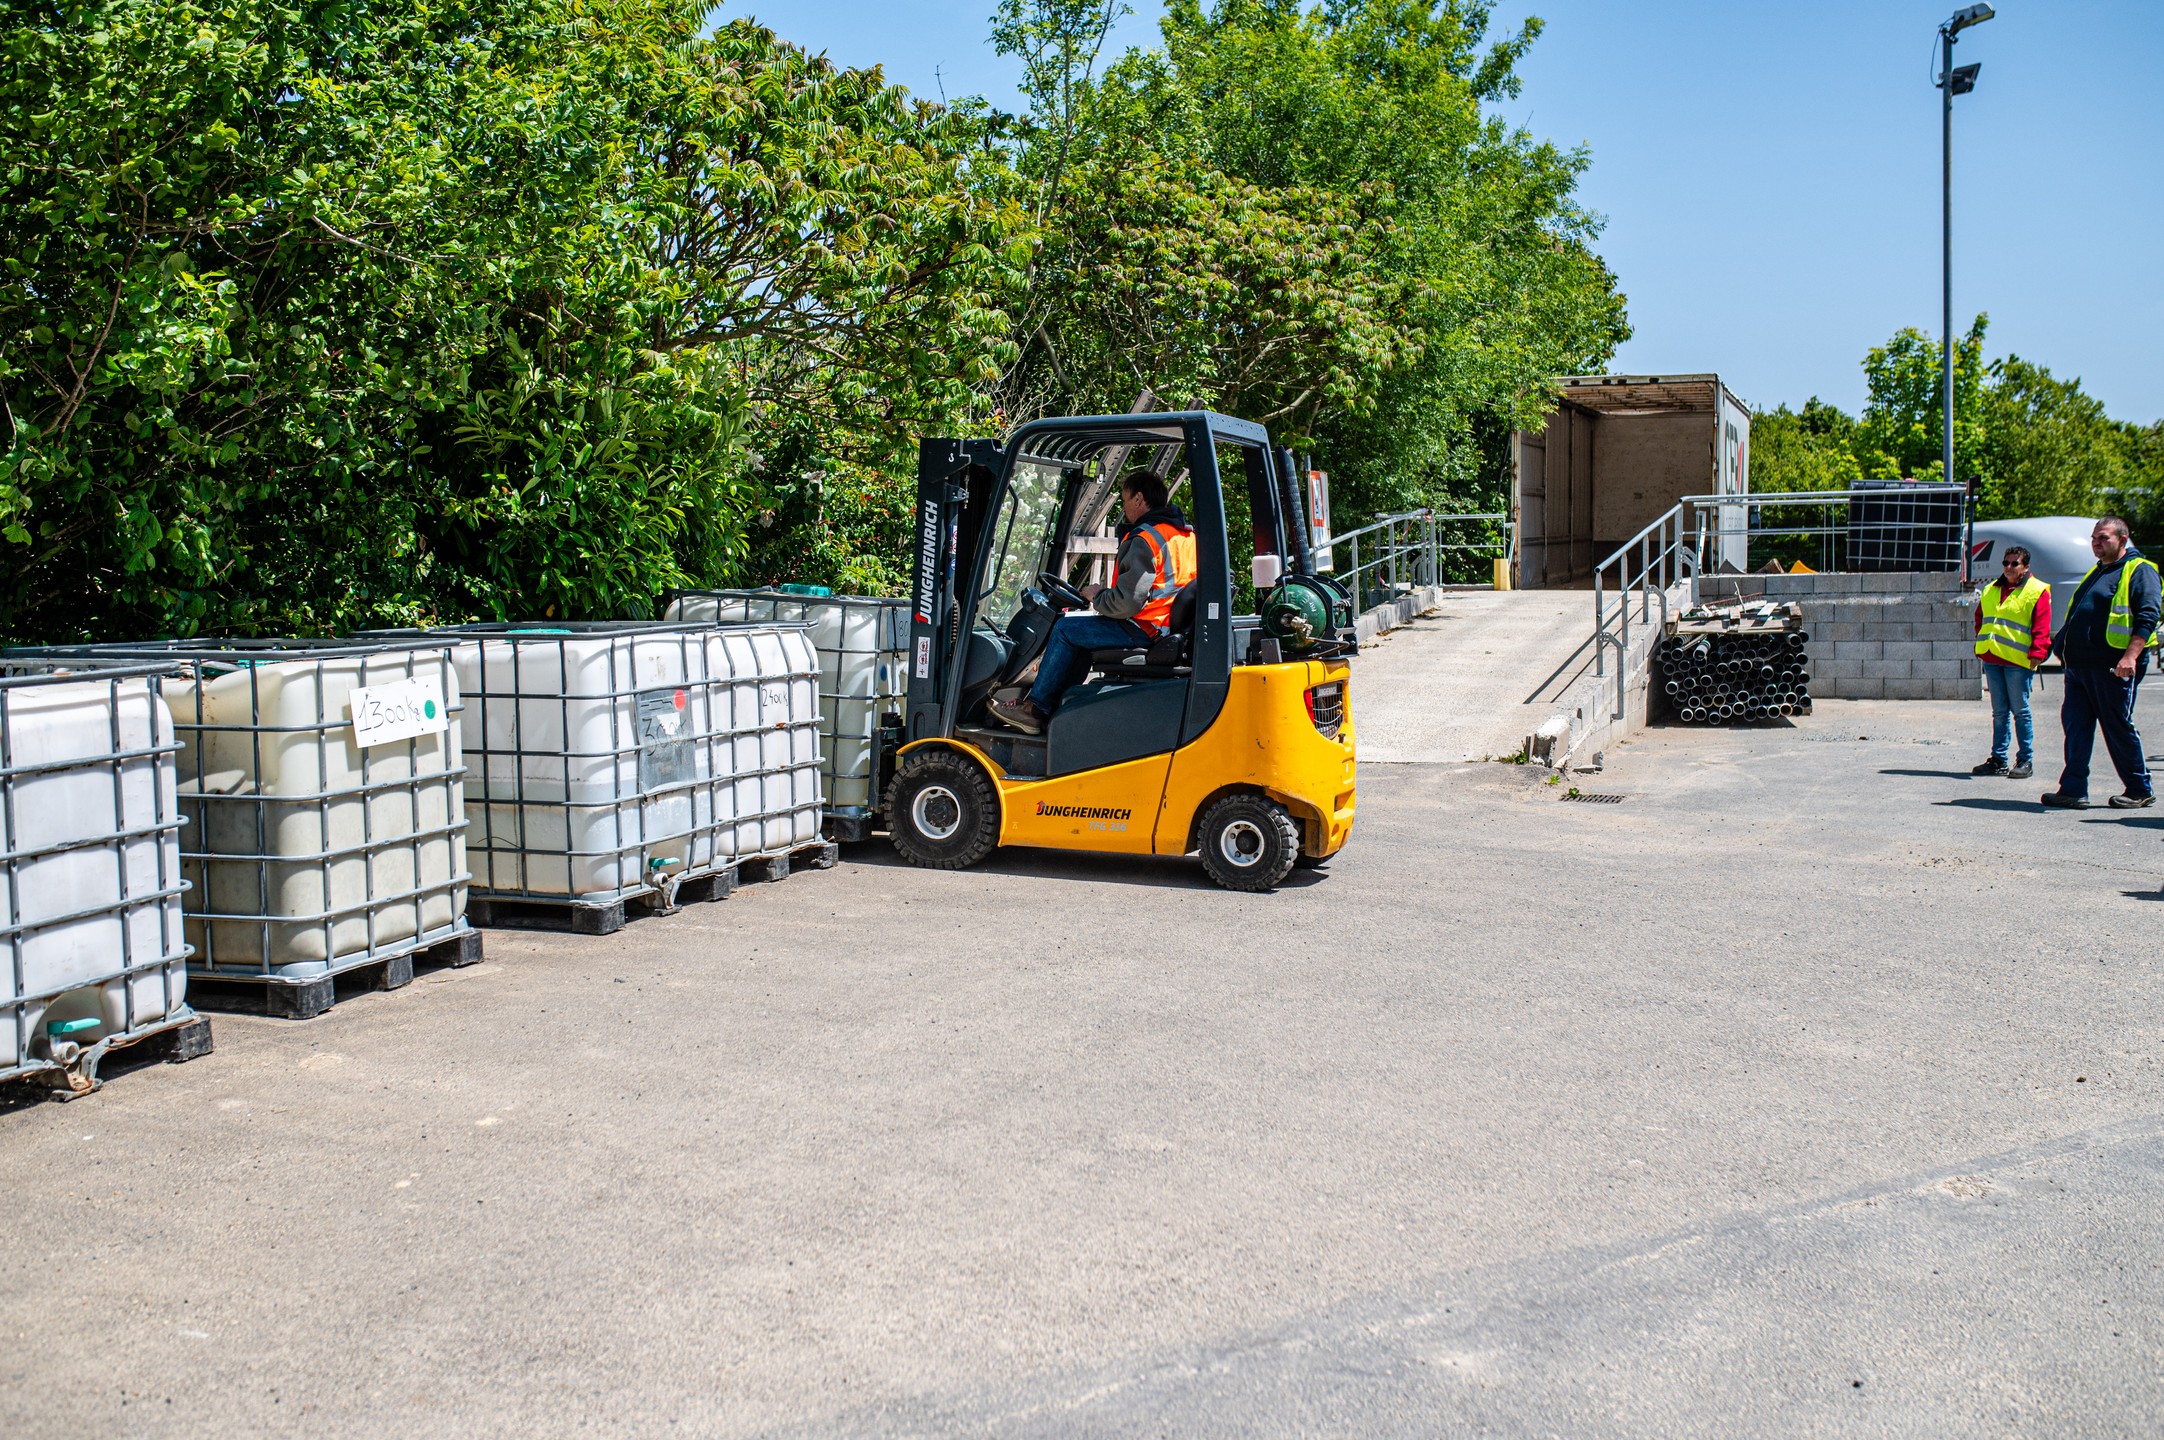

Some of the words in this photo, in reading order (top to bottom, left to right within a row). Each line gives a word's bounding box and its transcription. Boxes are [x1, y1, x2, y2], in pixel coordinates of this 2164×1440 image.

[915, 500, 938, 625] JUNGHEINRICH
[1036, 801, 1132, 820] JUNGHEINRICH
[1089, 821, 1107, 831] TFG
[1109, 822, 1127, 832] 316
